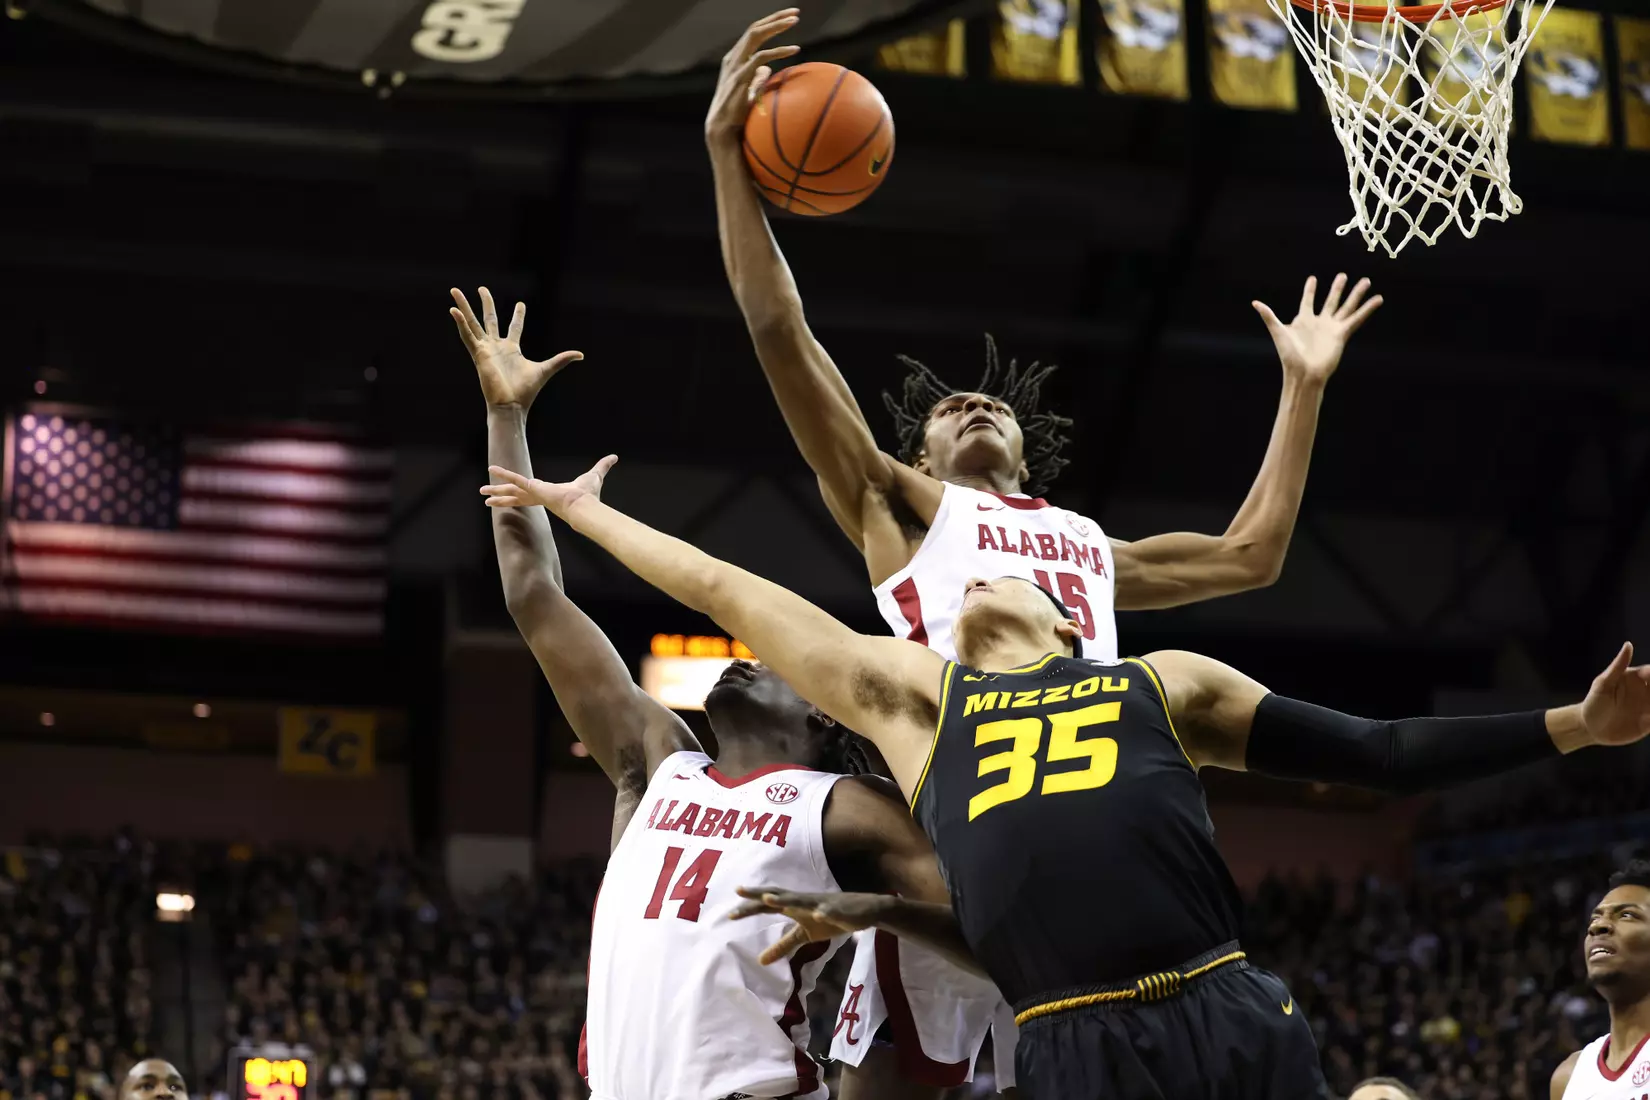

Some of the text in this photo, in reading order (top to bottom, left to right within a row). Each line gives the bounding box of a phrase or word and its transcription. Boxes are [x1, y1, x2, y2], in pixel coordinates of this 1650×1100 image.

[411, 0, 527, 62] GR
[977, 523, 1108, 580] ALABAMA
[962, 676, 1130, 718] MIZZOU
[967, 701, 1123, 823] 35
[766, 783, 799, 803] SEC
[645, 798, 793, 848] ALABAMA
[643, 846, 724, 923] 14
